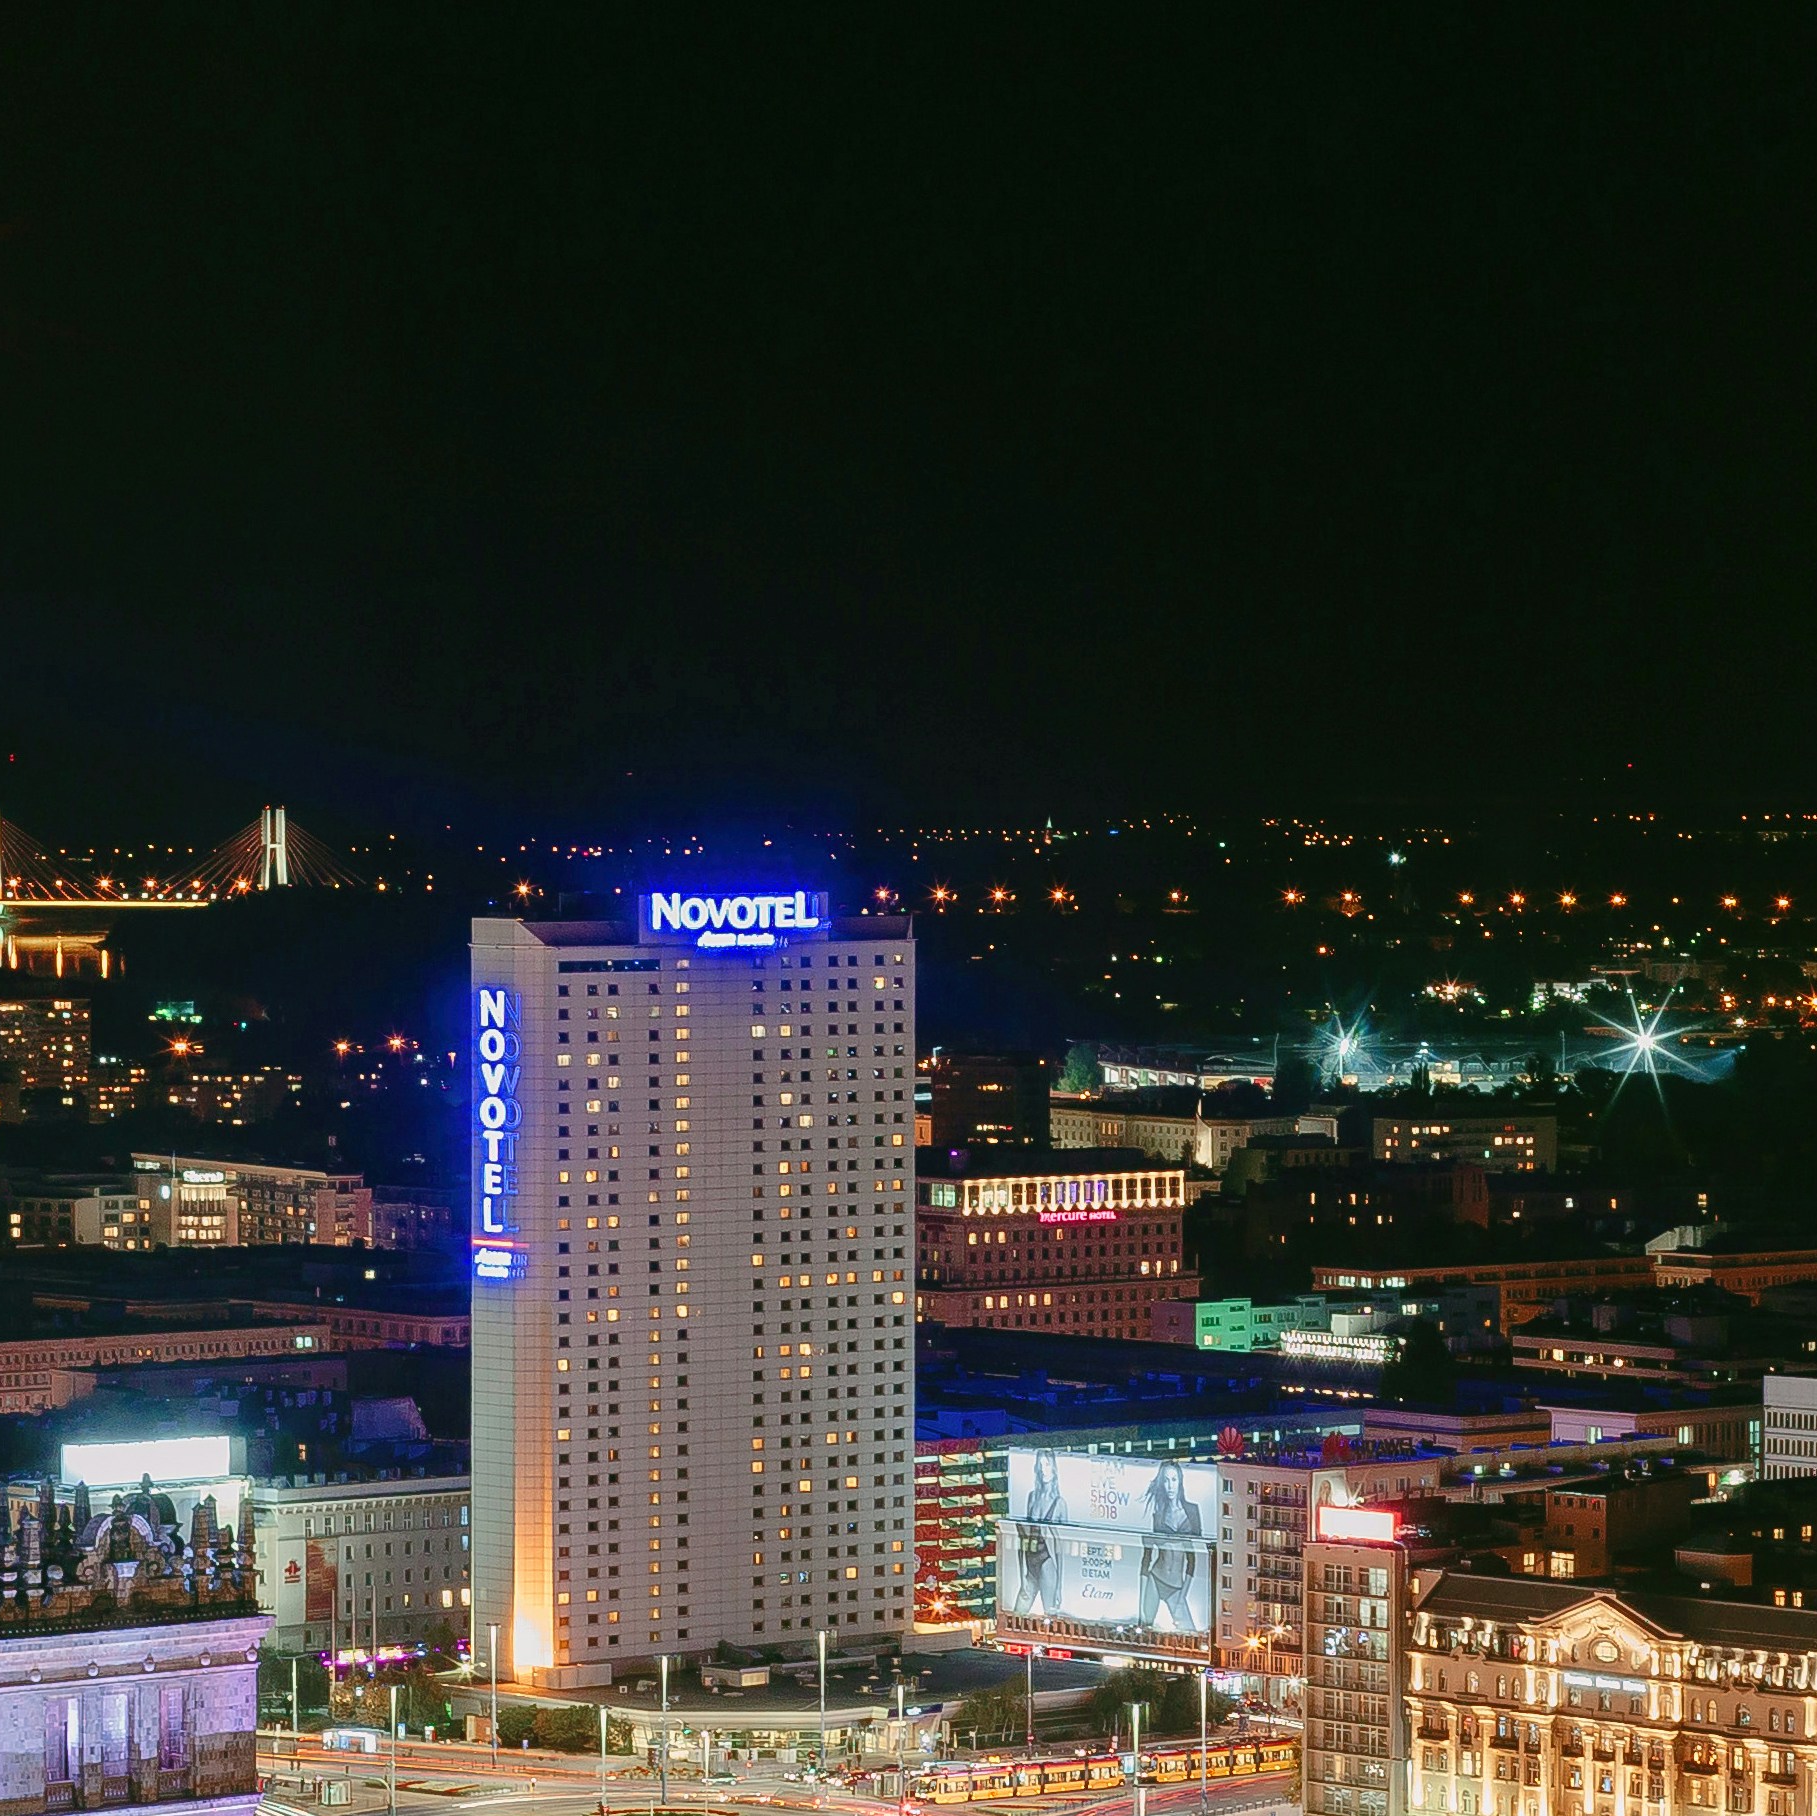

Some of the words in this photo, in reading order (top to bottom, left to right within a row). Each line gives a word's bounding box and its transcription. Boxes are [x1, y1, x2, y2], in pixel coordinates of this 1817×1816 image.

[651, 891, 820, 930] NOVOTEL
[478, 989, 507, 1234] NOVOTEL
[1088, 1211, 1117, 1220] HOTEL
[1090, 1489, 1130, 1506] SHOW
[1089, 1503, 1118, 1519] 2018
[1081, 1583, 1114, 1600] Etam
